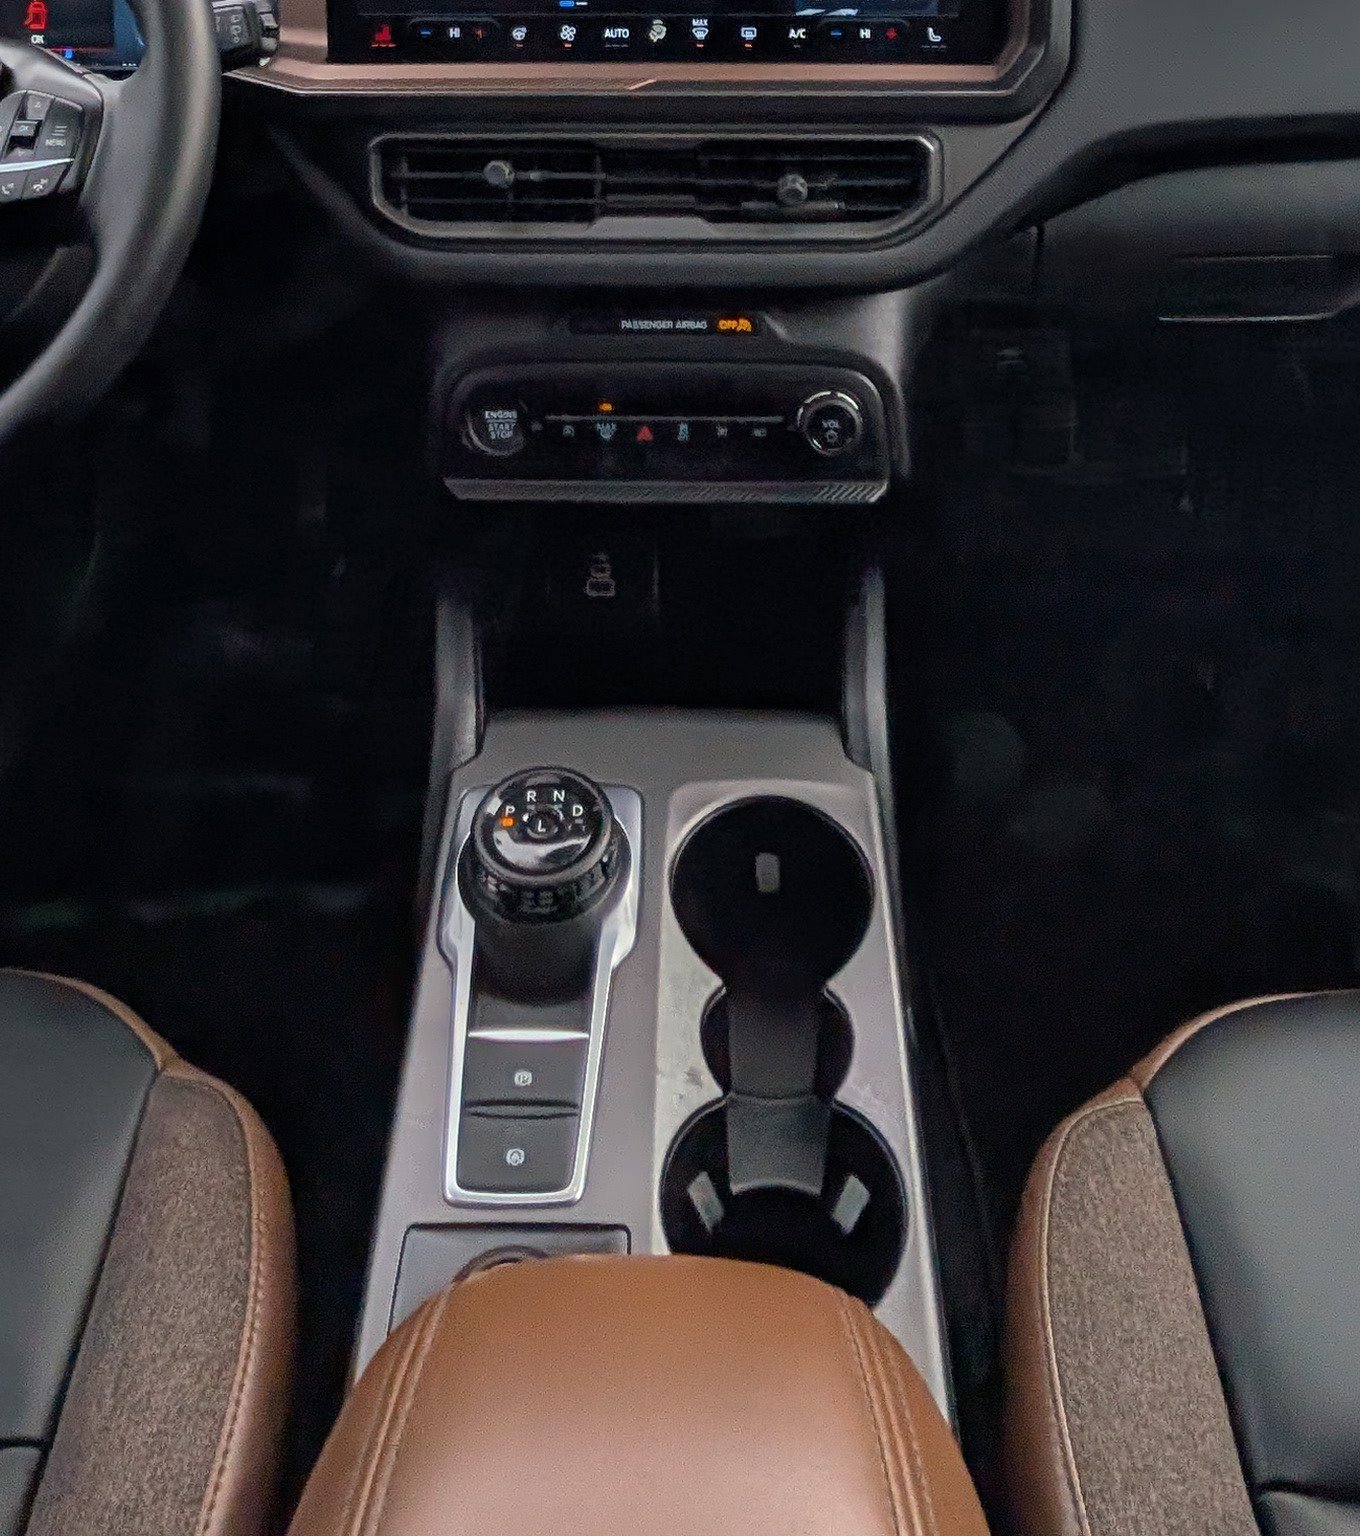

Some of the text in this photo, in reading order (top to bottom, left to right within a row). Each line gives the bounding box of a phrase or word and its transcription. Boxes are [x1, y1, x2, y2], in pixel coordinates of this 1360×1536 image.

[449, 27, 461, 38] HI
[604, 28, 630, 39] AUTO
[789, 28, 806, 39] A/C
[860, 28, 871, 39] HI
[31, 34, 45, 44] OK
[621, 319, 674, 330] PASSENGER
[675, 319, 708, 330] AIRBAG
[490, 430, 513, 440] STOP
[526, 790, 537, 802] R
[553, 790, 565, 803] N
[505, 805, 516, 817] P
[572, 804, 584, 817] D
[537, 819, 547, 833] L
